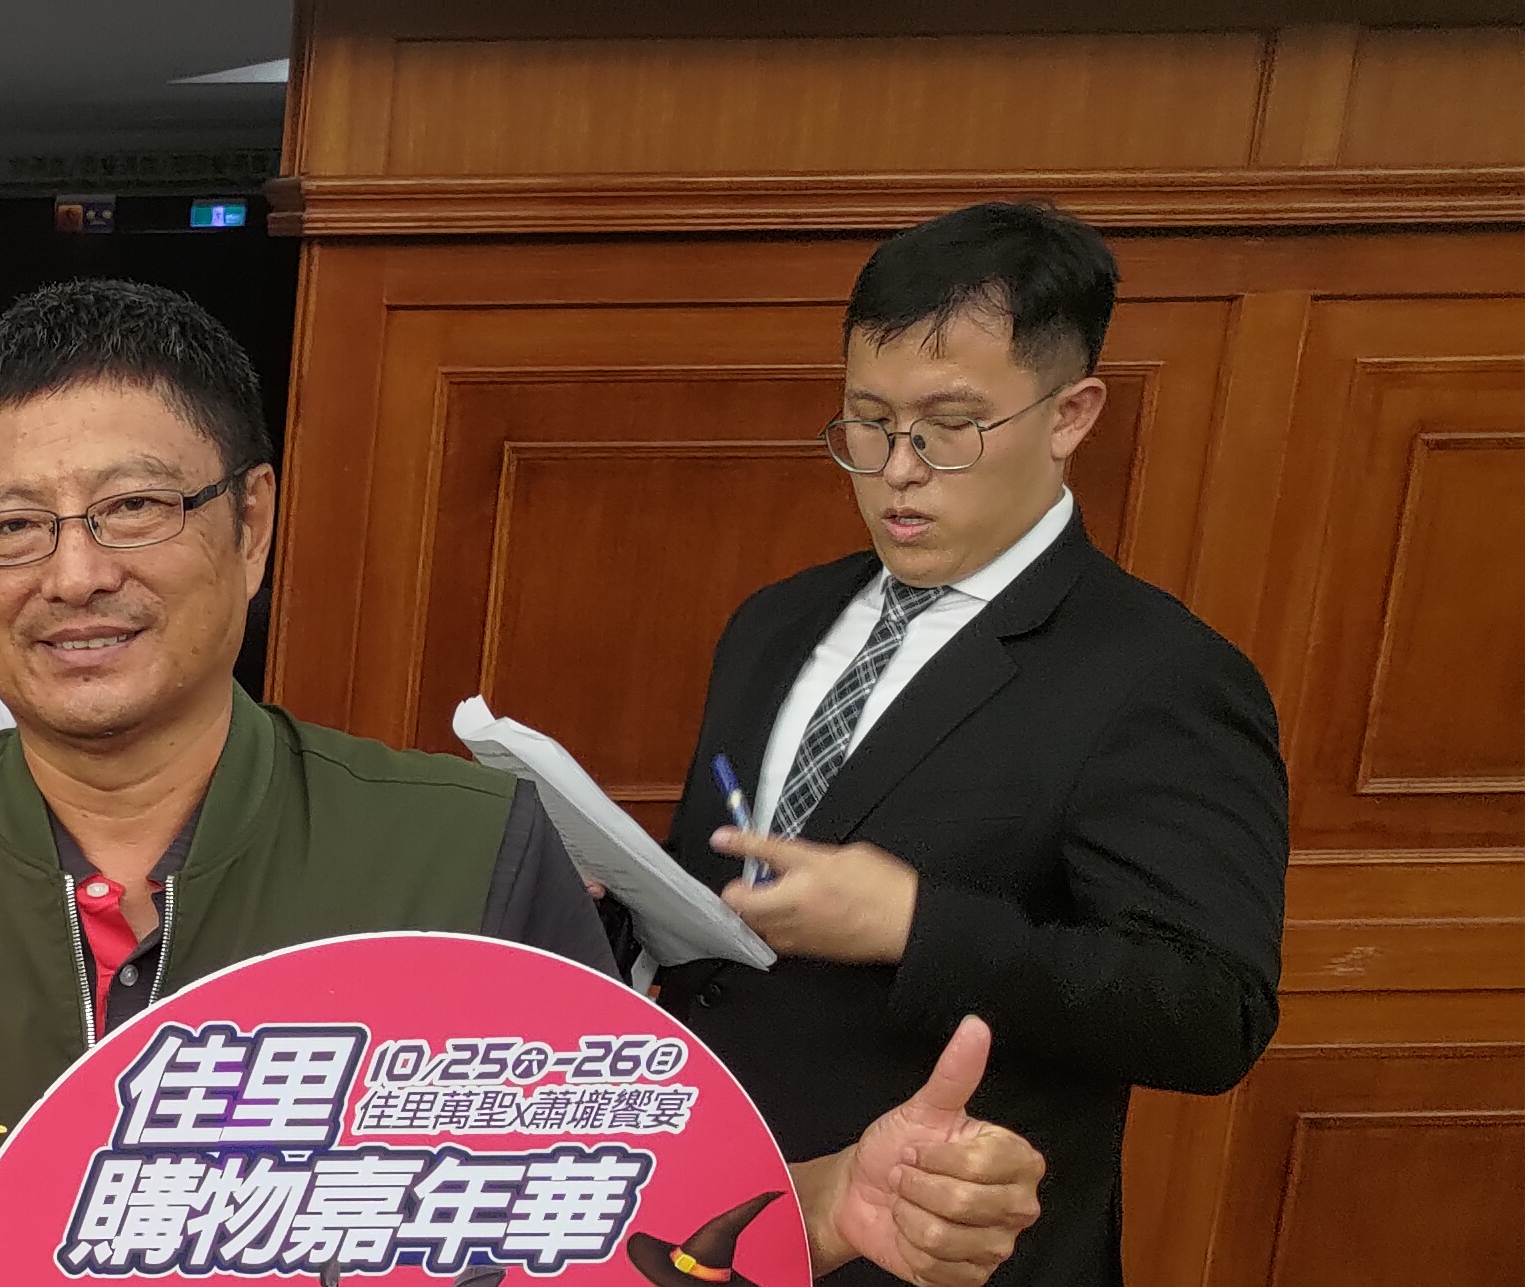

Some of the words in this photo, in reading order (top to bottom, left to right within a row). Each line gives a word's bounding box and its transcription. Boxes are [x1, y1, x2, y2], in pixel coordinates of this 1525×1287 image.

[115, 1030, 361, 1149] 佳里
[65, 1152, 641, 1268] 購物嘉年華
